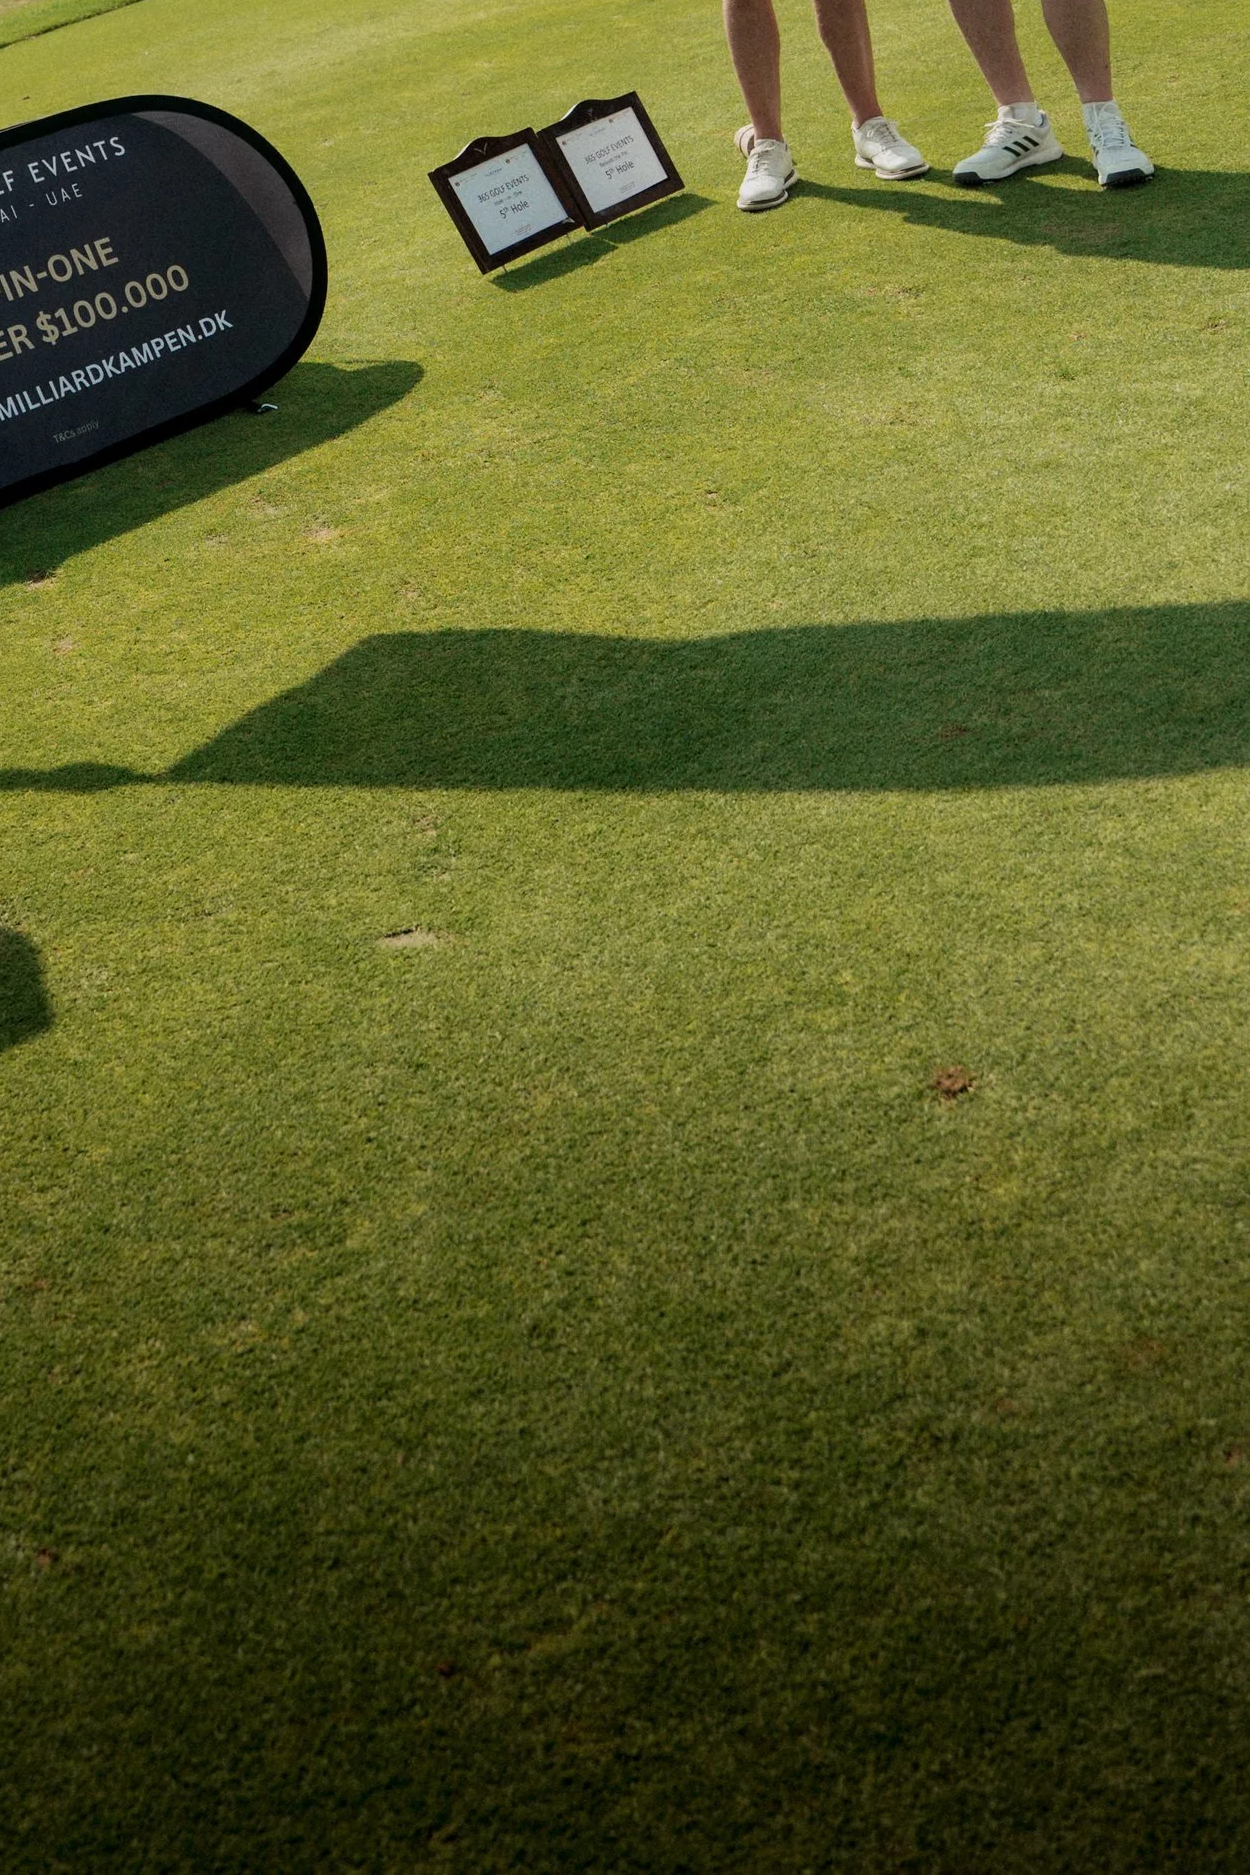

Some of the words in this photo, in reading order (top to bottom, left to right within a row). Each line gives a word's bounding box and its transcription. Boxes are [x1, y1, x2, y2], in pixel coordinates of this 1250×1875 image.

[595, 145, 610, 158] GOLF
[610, 135, 634, 151] EVENTS
[27, 136, 126, 183] EVENTS
[615, 161, 634, 174] Hole
[45, 183, 83, 206] UAE
[489, 185, 505, 198] GOLF
[505, 174, 529, 191] EVENTS
[510, 200, 530, 214] Hole
[35, 264, 189, 347] $100.000
